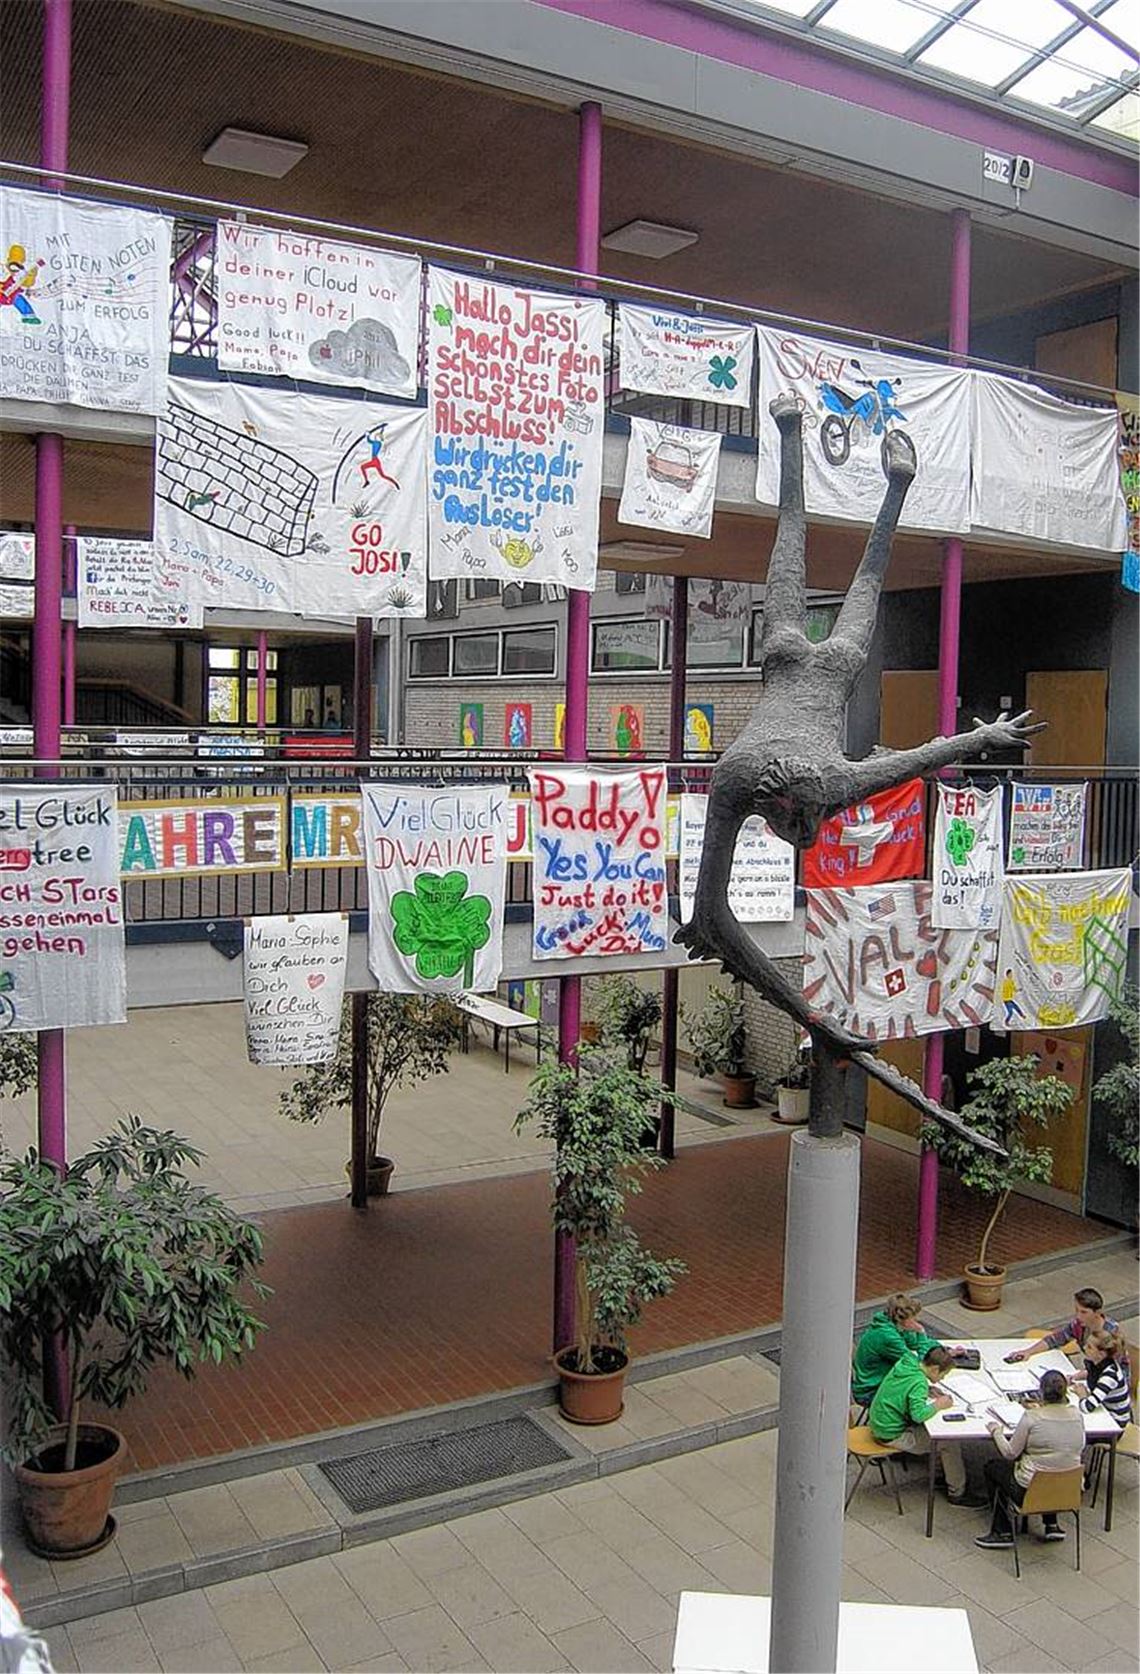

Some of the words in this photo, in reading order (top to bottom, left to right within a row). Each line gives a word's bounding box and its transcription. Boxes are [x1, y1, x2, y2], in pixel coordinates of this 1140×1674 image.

[46, 232, 70, 249] MIT
[50, 254, 101, 273] GUTEN
[108, 237, 156, 270] NOTEN
[223, 223, 260, 247] Wir
[277, 233, 351, 264] hoffen
[356, 252, 376, 269] in
[225, 253, 295, 282] deiner
[303, 264, 358, 294] iCloud
[368, 282, 399, 302] war
[58, 300, 86, 312] ZUM
[94, 305, 149, 321] ERFOLG
[225, 291, 288, 315] genug
[295, 292, 356, 323] Platz!
[454, 280, 512, 326] Hallo
[513, 290, 582, 343] Jassi
[46, 322, 93, 344] ANJA
[222, 322, 261, 339] Good
[1, 355, 57, 373] DRÜCKEN
[23, 336, 42, 351] DU
[49, 340, 116, 364] SCHAFFST
[124, 354, 149, 369] DAS
[455, 325, 518, 362] mach
[523, 335, 557, 367] dir
[558, 342, 601, 377] dein
[23, 373, 41, 384] DIE
[558, 369, 599, 404] Foto
[434, 435, 471, 467] Wir
[470, 435, 547, 475] drücken
[551, 440, 583, 479] dir
[432, 469, 483, 500] ganz
[488, 473, 535, 502] fest
[536, 472, 574, 505] den
[351, 523, 382, 547] GO
[349, 549, 412, 578] JOSI!
[35, 798, 111, 830] Glück
[367, 791, 426, 831] Viel
[430, 796, 504, 832] Glück
[120, 810, 277, 871] AHRE
[374, 834, 495, 871] DWAINE
[539, 837, 588, 882] Yes
[592, 842, 632, 882] You
[634, 852, 666, 882] Can
[942, 870, 958, 887] Du
[541, 883, 595, 909] Just
[602, 887, 627, 906] do
[632, 879, 664, 914] it!
[942, 889, 965, 910] das!
[3, 931, 87, 958] gehen
[269, 955, 325, 973] glauben
[247, 977, 289, 994] Dich
[249, 999, 270, 1016] Viel
[276, 996, 321, 1015] Glück
[307, 1013, 334, 1026] Dir
